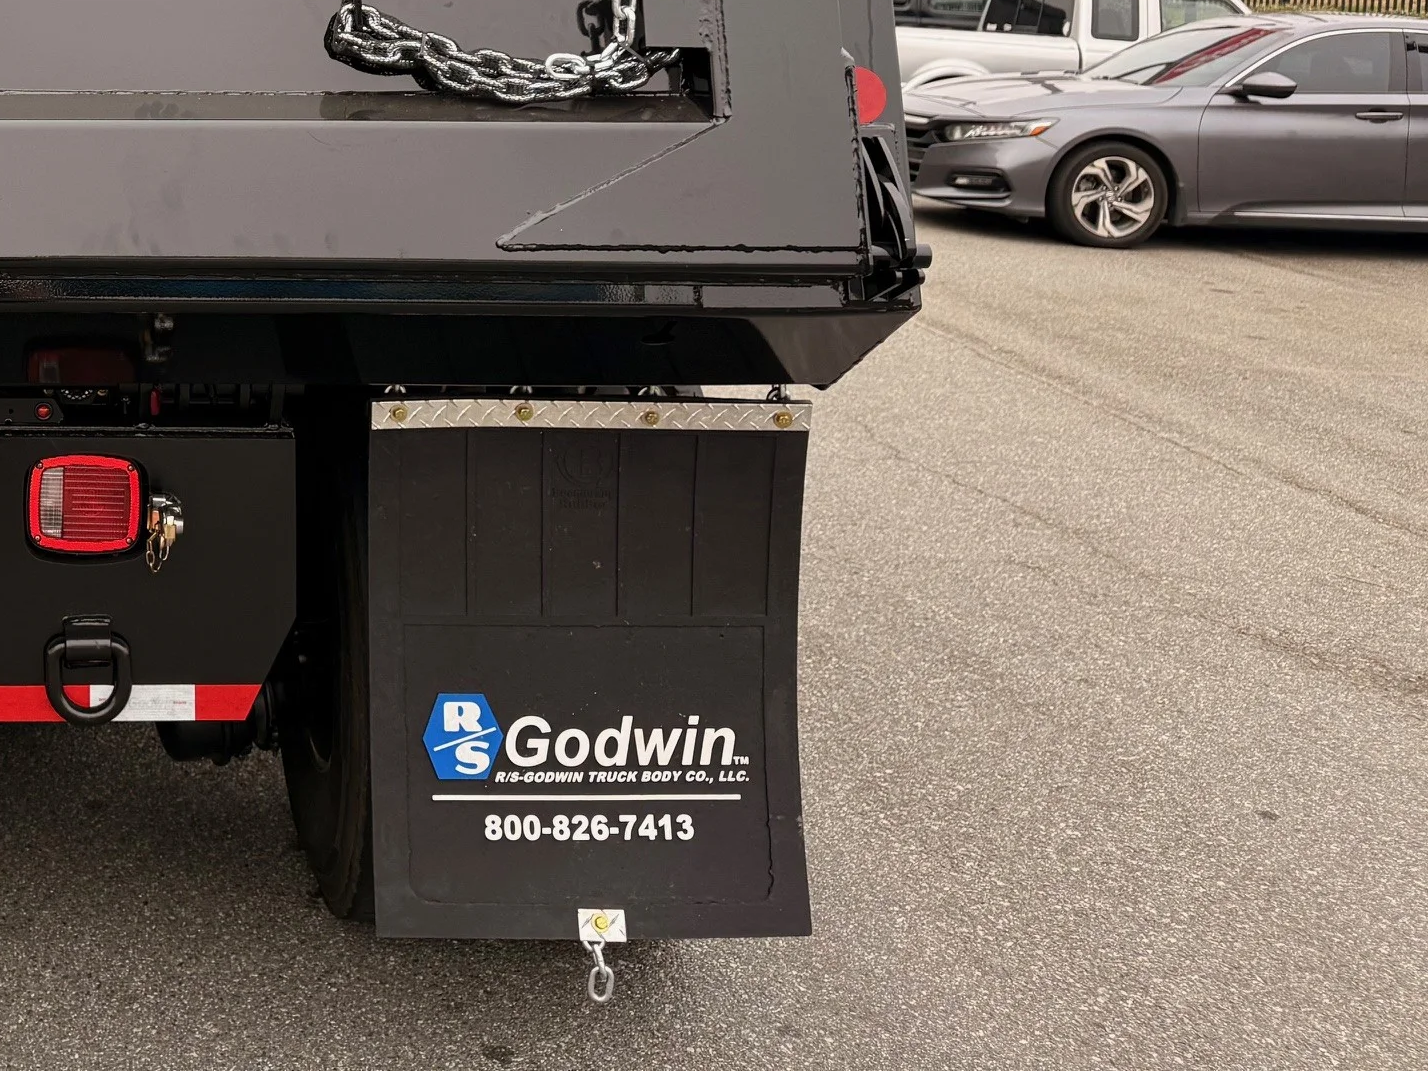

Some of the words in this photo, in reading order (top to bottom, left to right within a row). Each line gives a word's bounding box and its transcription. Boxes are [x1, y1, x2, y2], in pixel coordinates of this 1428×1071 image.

[505, 715, 737, 767] Godwin
[494, 771, 584, 783] R/S-GODWIN
[588, 771, 638, 783] TRUCK
[641, 770, 682, 782] BODY
[685, 770, 714, 784] CO.,
[718, 770, 750, 782] LLC.
[484, 814, 695, 841] 800-826-7413
